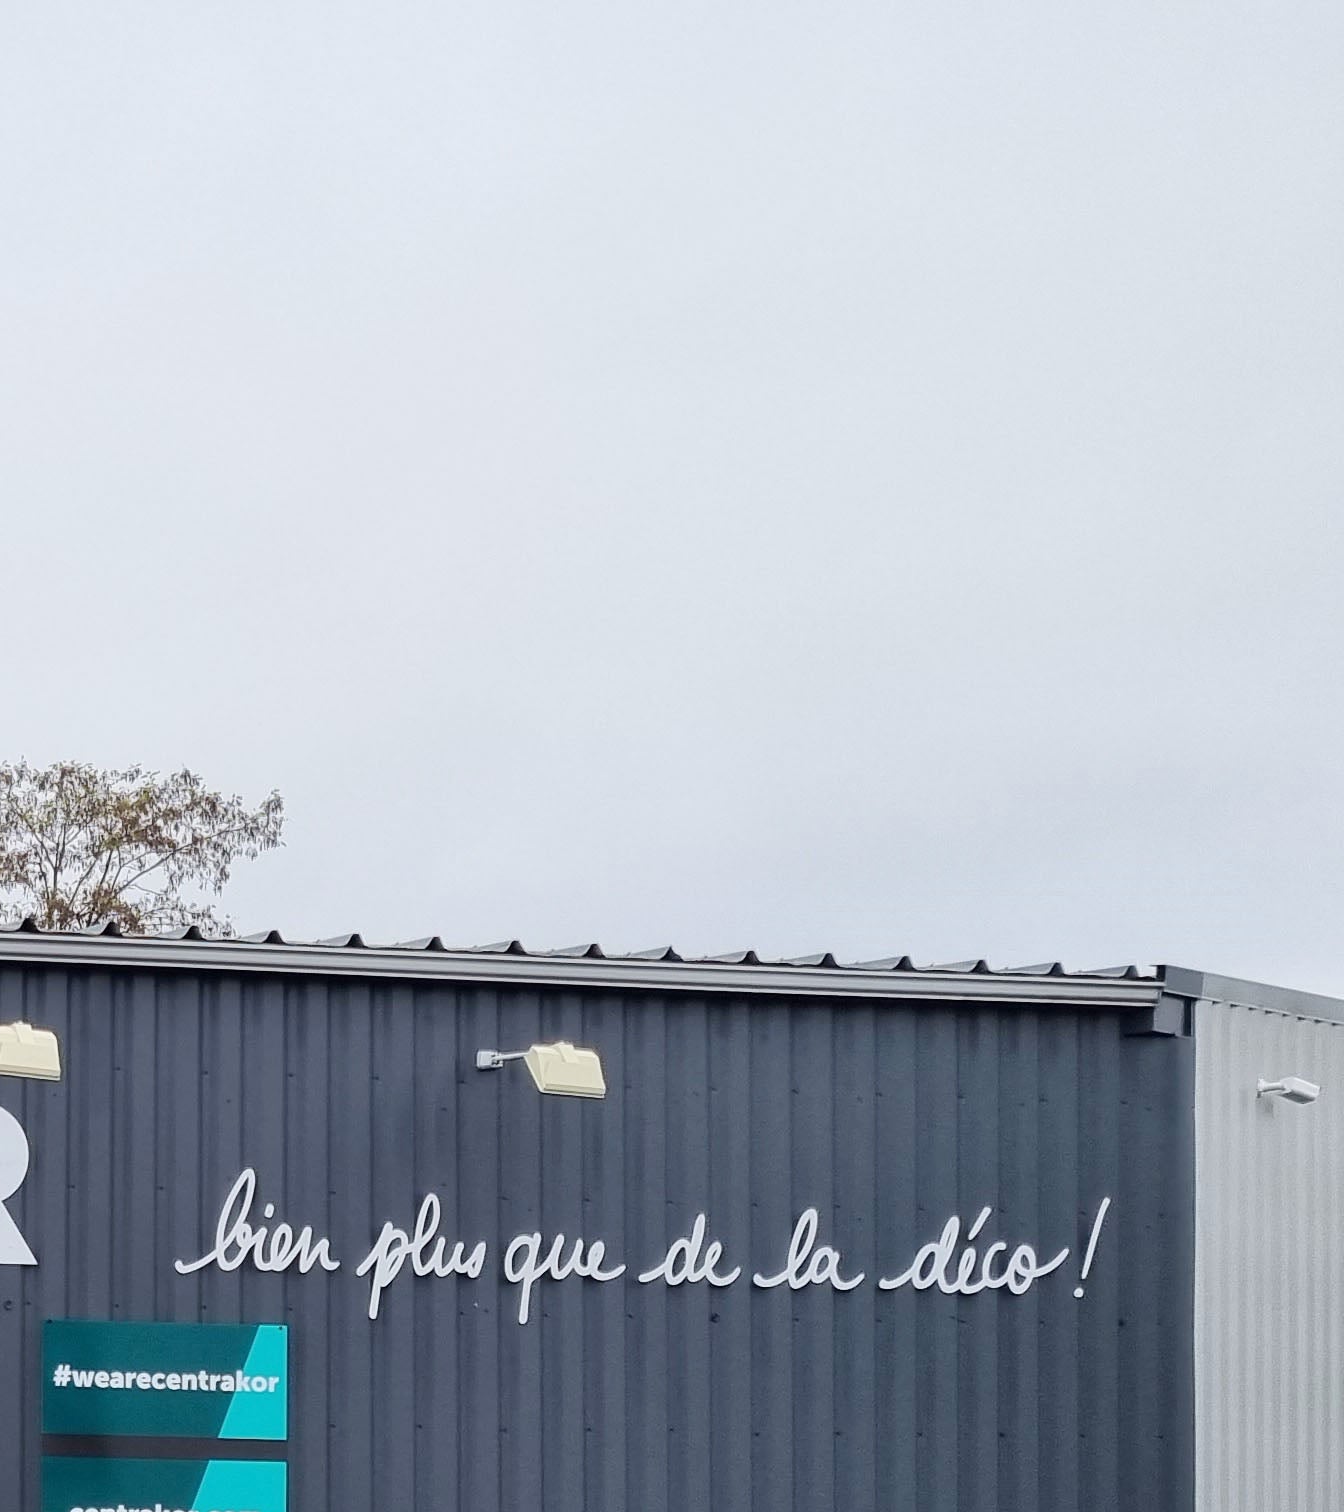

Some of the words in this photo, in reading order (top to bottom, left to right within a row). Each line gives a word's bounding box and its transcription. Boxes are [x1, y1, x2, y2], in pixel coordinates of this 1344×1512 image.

[175, 1169, 341, 1275] bien
[357, 1193, 488, 1320] plus
[503, 1232, 626, 1325] que
[638, 1213, 741, 1289] de
[752, 1207, 865, 1292] la
[878, 1206, 1069, 1297] déco
[52, 1364, 280, 1394] #wearecentrakor
